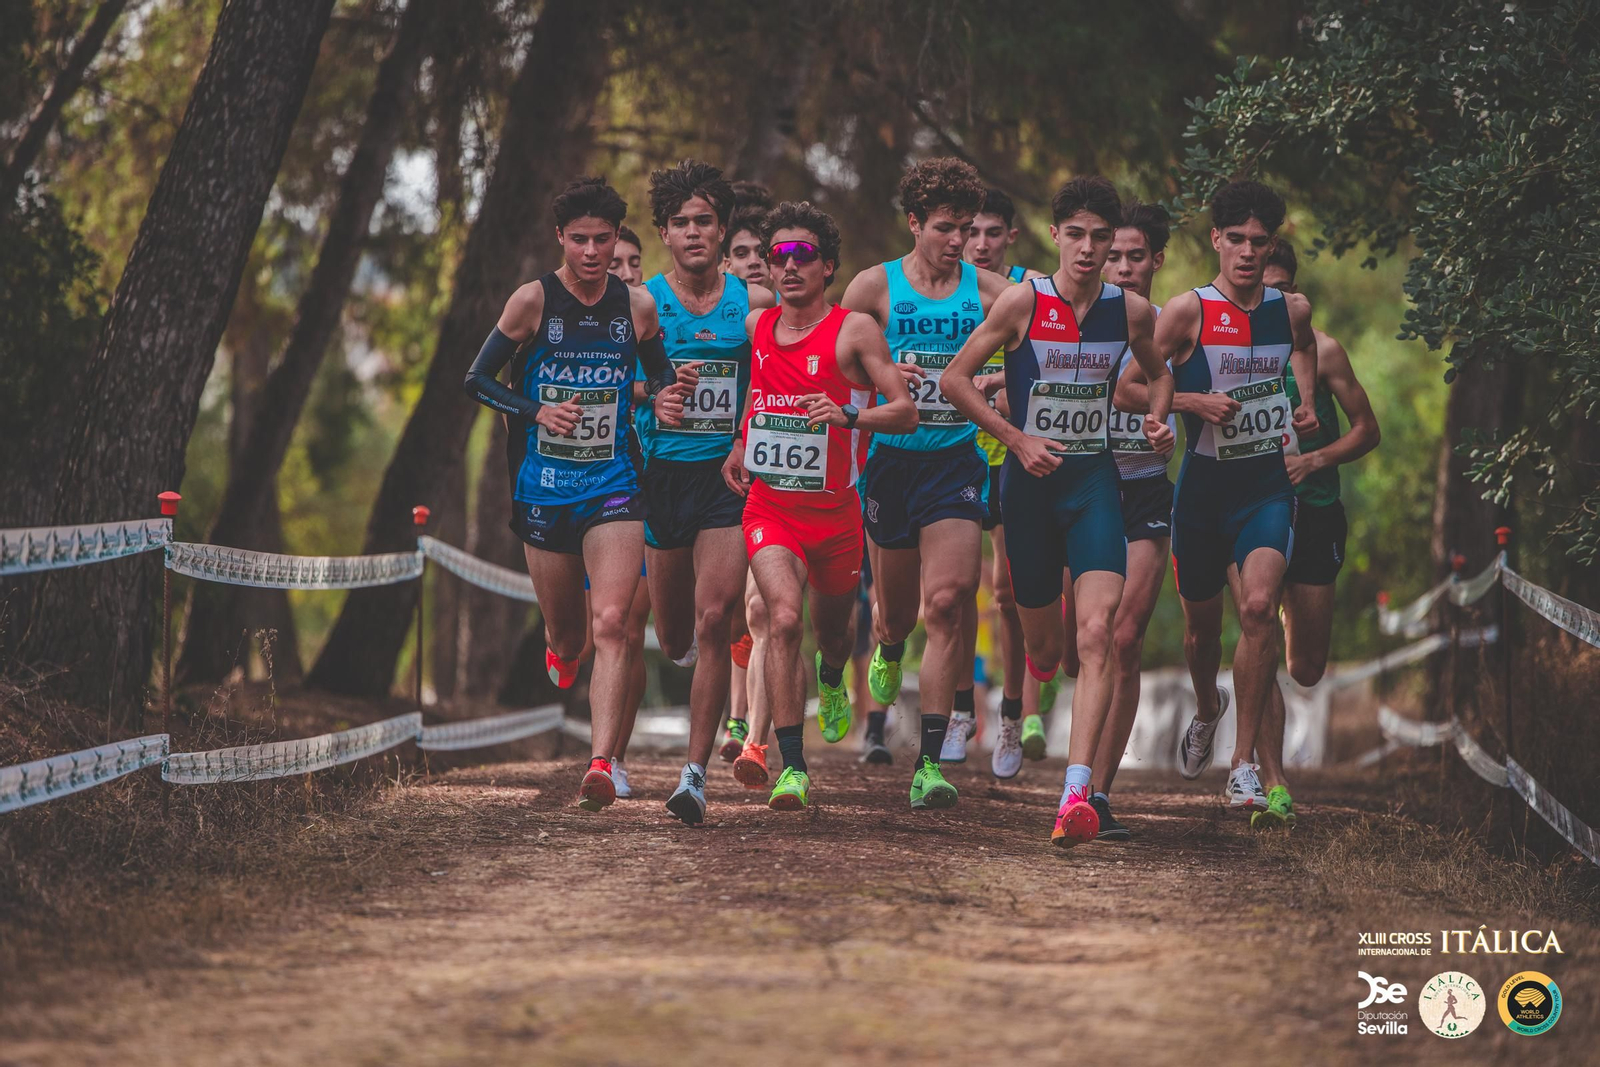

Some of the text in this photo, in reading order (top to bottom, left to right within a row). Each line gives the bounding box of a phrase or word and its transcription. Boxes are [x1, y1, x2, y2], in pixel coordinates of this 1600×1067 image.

[896, 311, 976, 341] nerja
[1041, 320, 1066, 331] VIATOR
[1212, 325, 1239, 335] VIATOR
[553, 351, 621, 360] CLUB ATLETISMO
[538, 361, 628, 384] NARÓN
[1055, 384, 1093, 395] ITÁLICA
[770, 416, 806, 429] ITÁLICA
[1035, 407, 1103, 435] 6400
[1221, 405, 1285, 440] 6402
[753, 441, 820, 471] 6162
[557, 475, 607, 488] DE GALICIA
